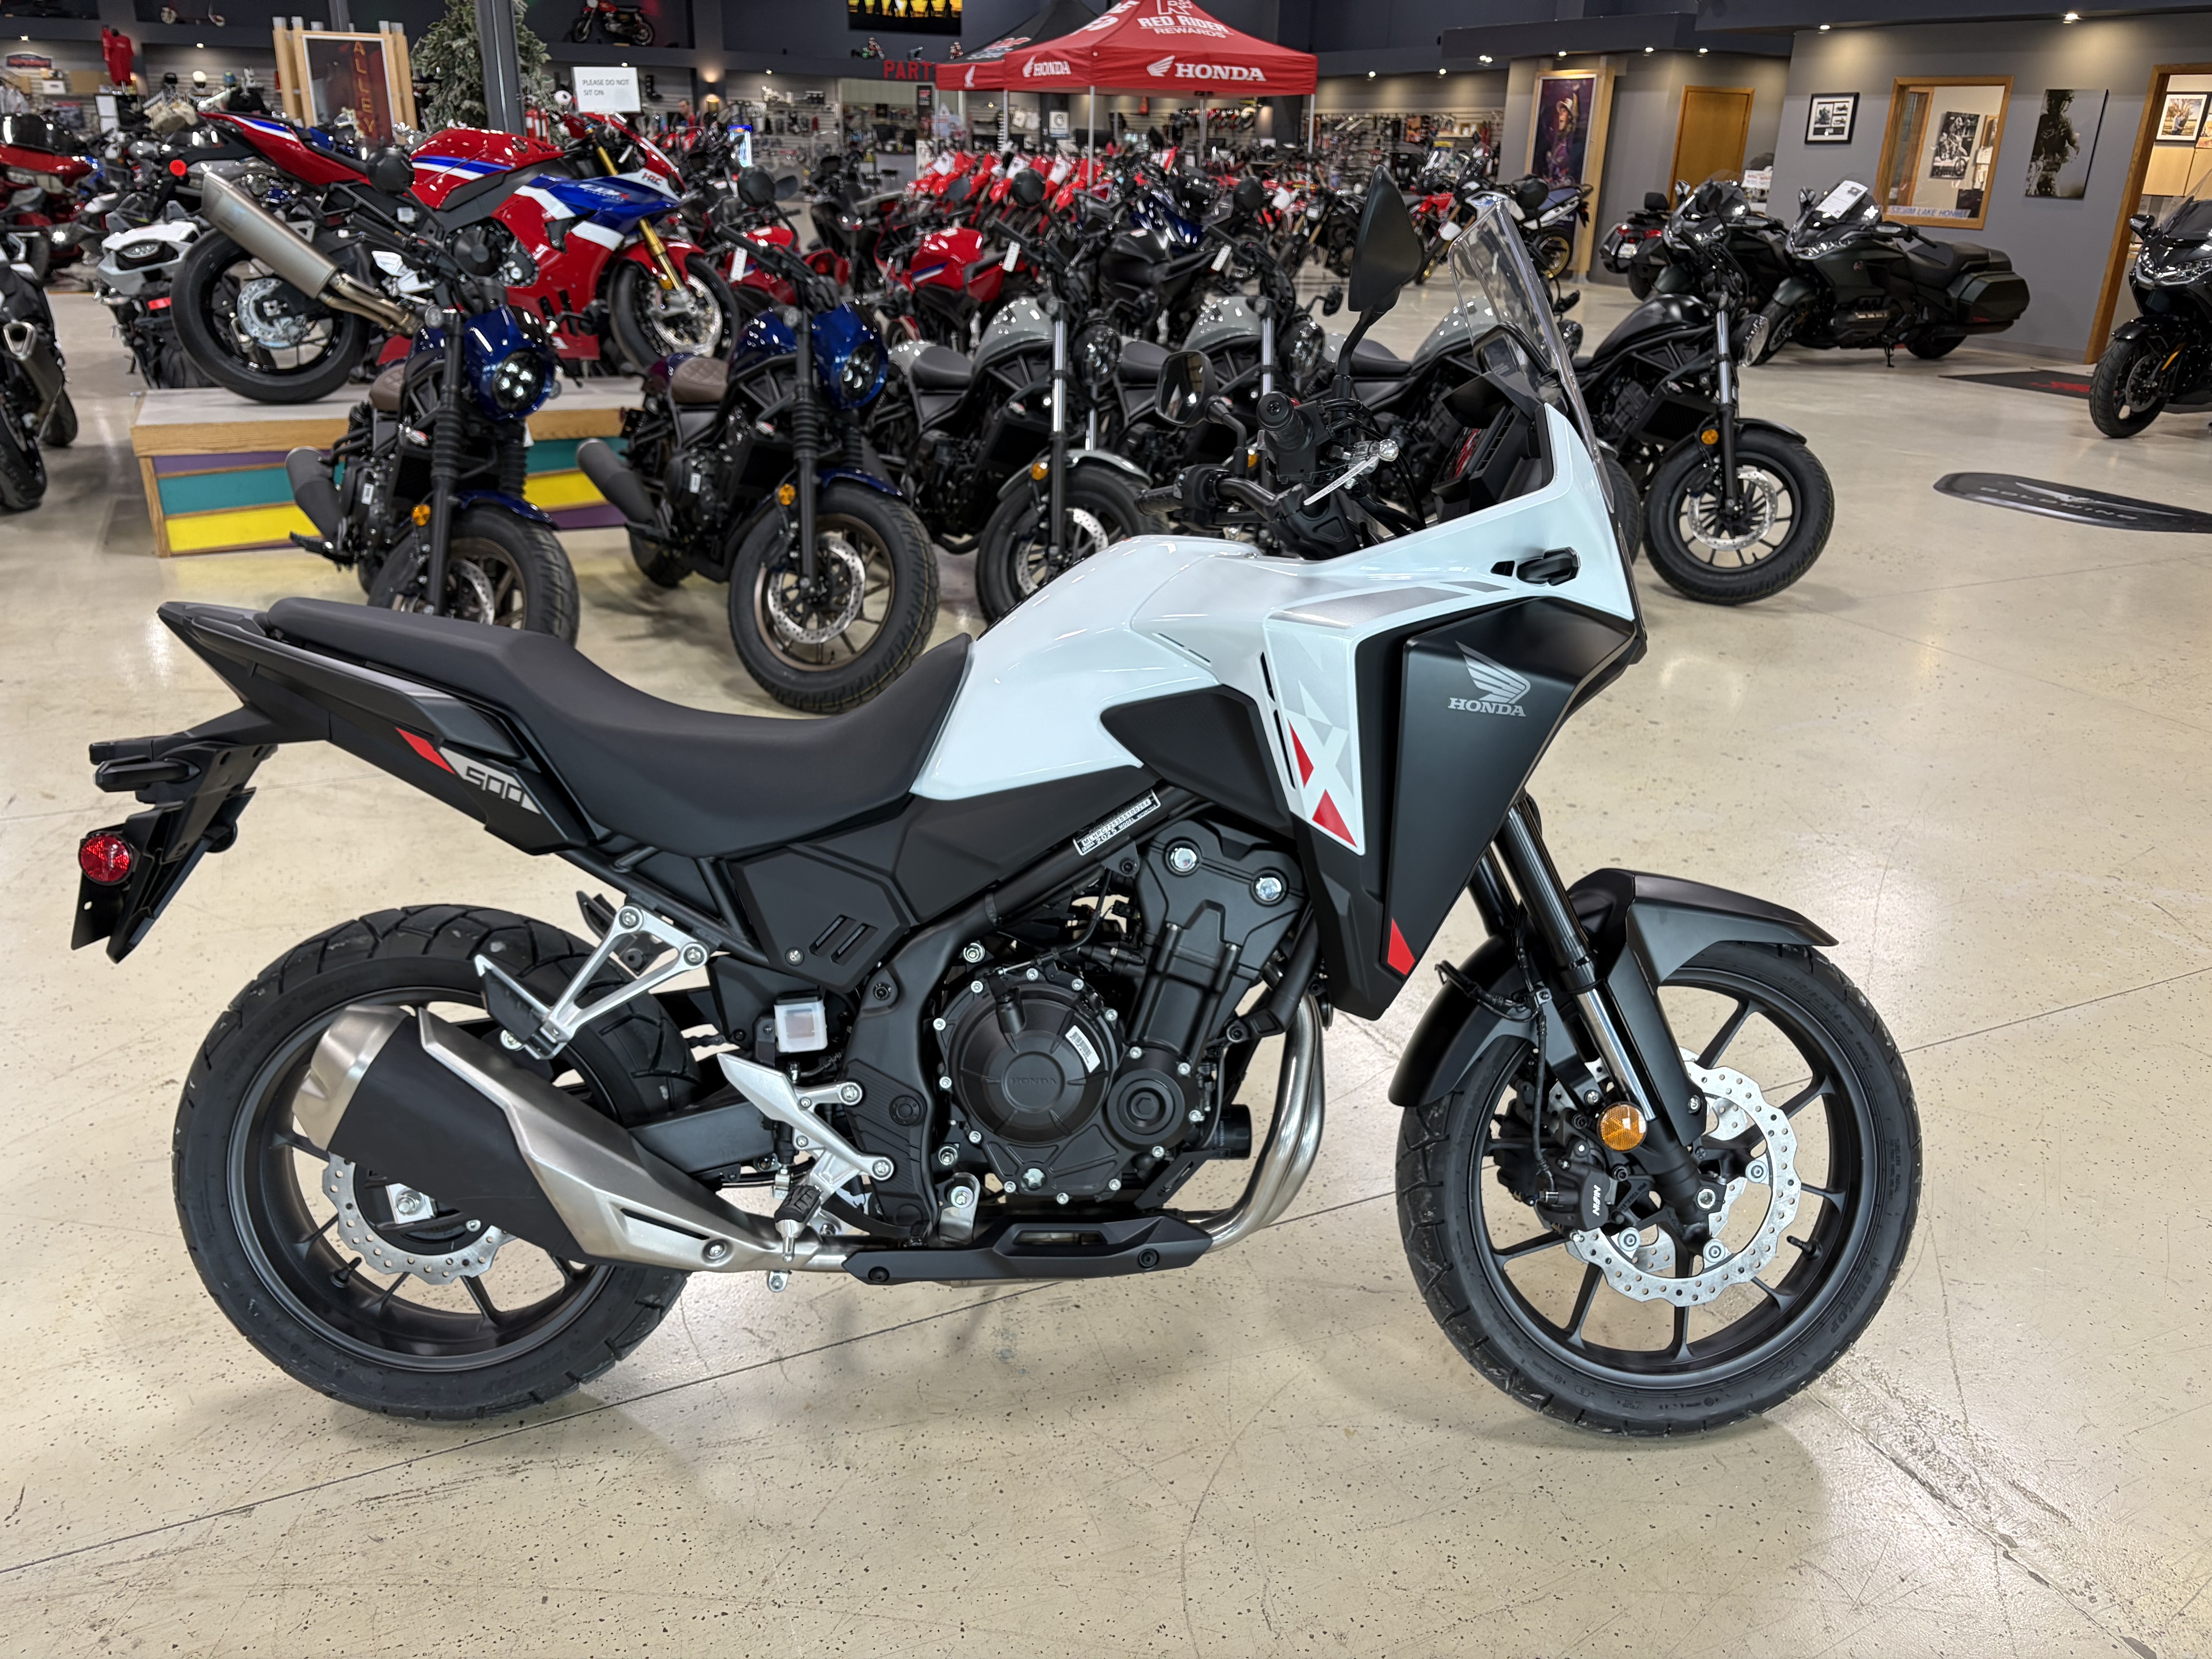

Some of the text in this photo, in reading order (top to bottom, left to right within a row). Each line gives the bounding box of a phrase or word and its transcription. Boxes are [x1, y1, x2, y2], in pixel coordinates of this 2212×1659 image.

[1137, 15, 1230, 33] RED RIDER
[1154, 28, 1227, 38] REWARDS
[884, 60, 934, 81] PART
[1033, 61, 1072, 76] HONDA
[1175, 63, 1267, 81] HONDA
[354, 41, 374, 132] ALLEY
[1448, 697, 1526, 717] HONDA
[466, 766, 525, 807] 500
[1095, 828, 1117, 844] 2025
[1118, 817, 1136, 830] MODEL
[1830, 1269, 1874, 1334] DUNLOP
